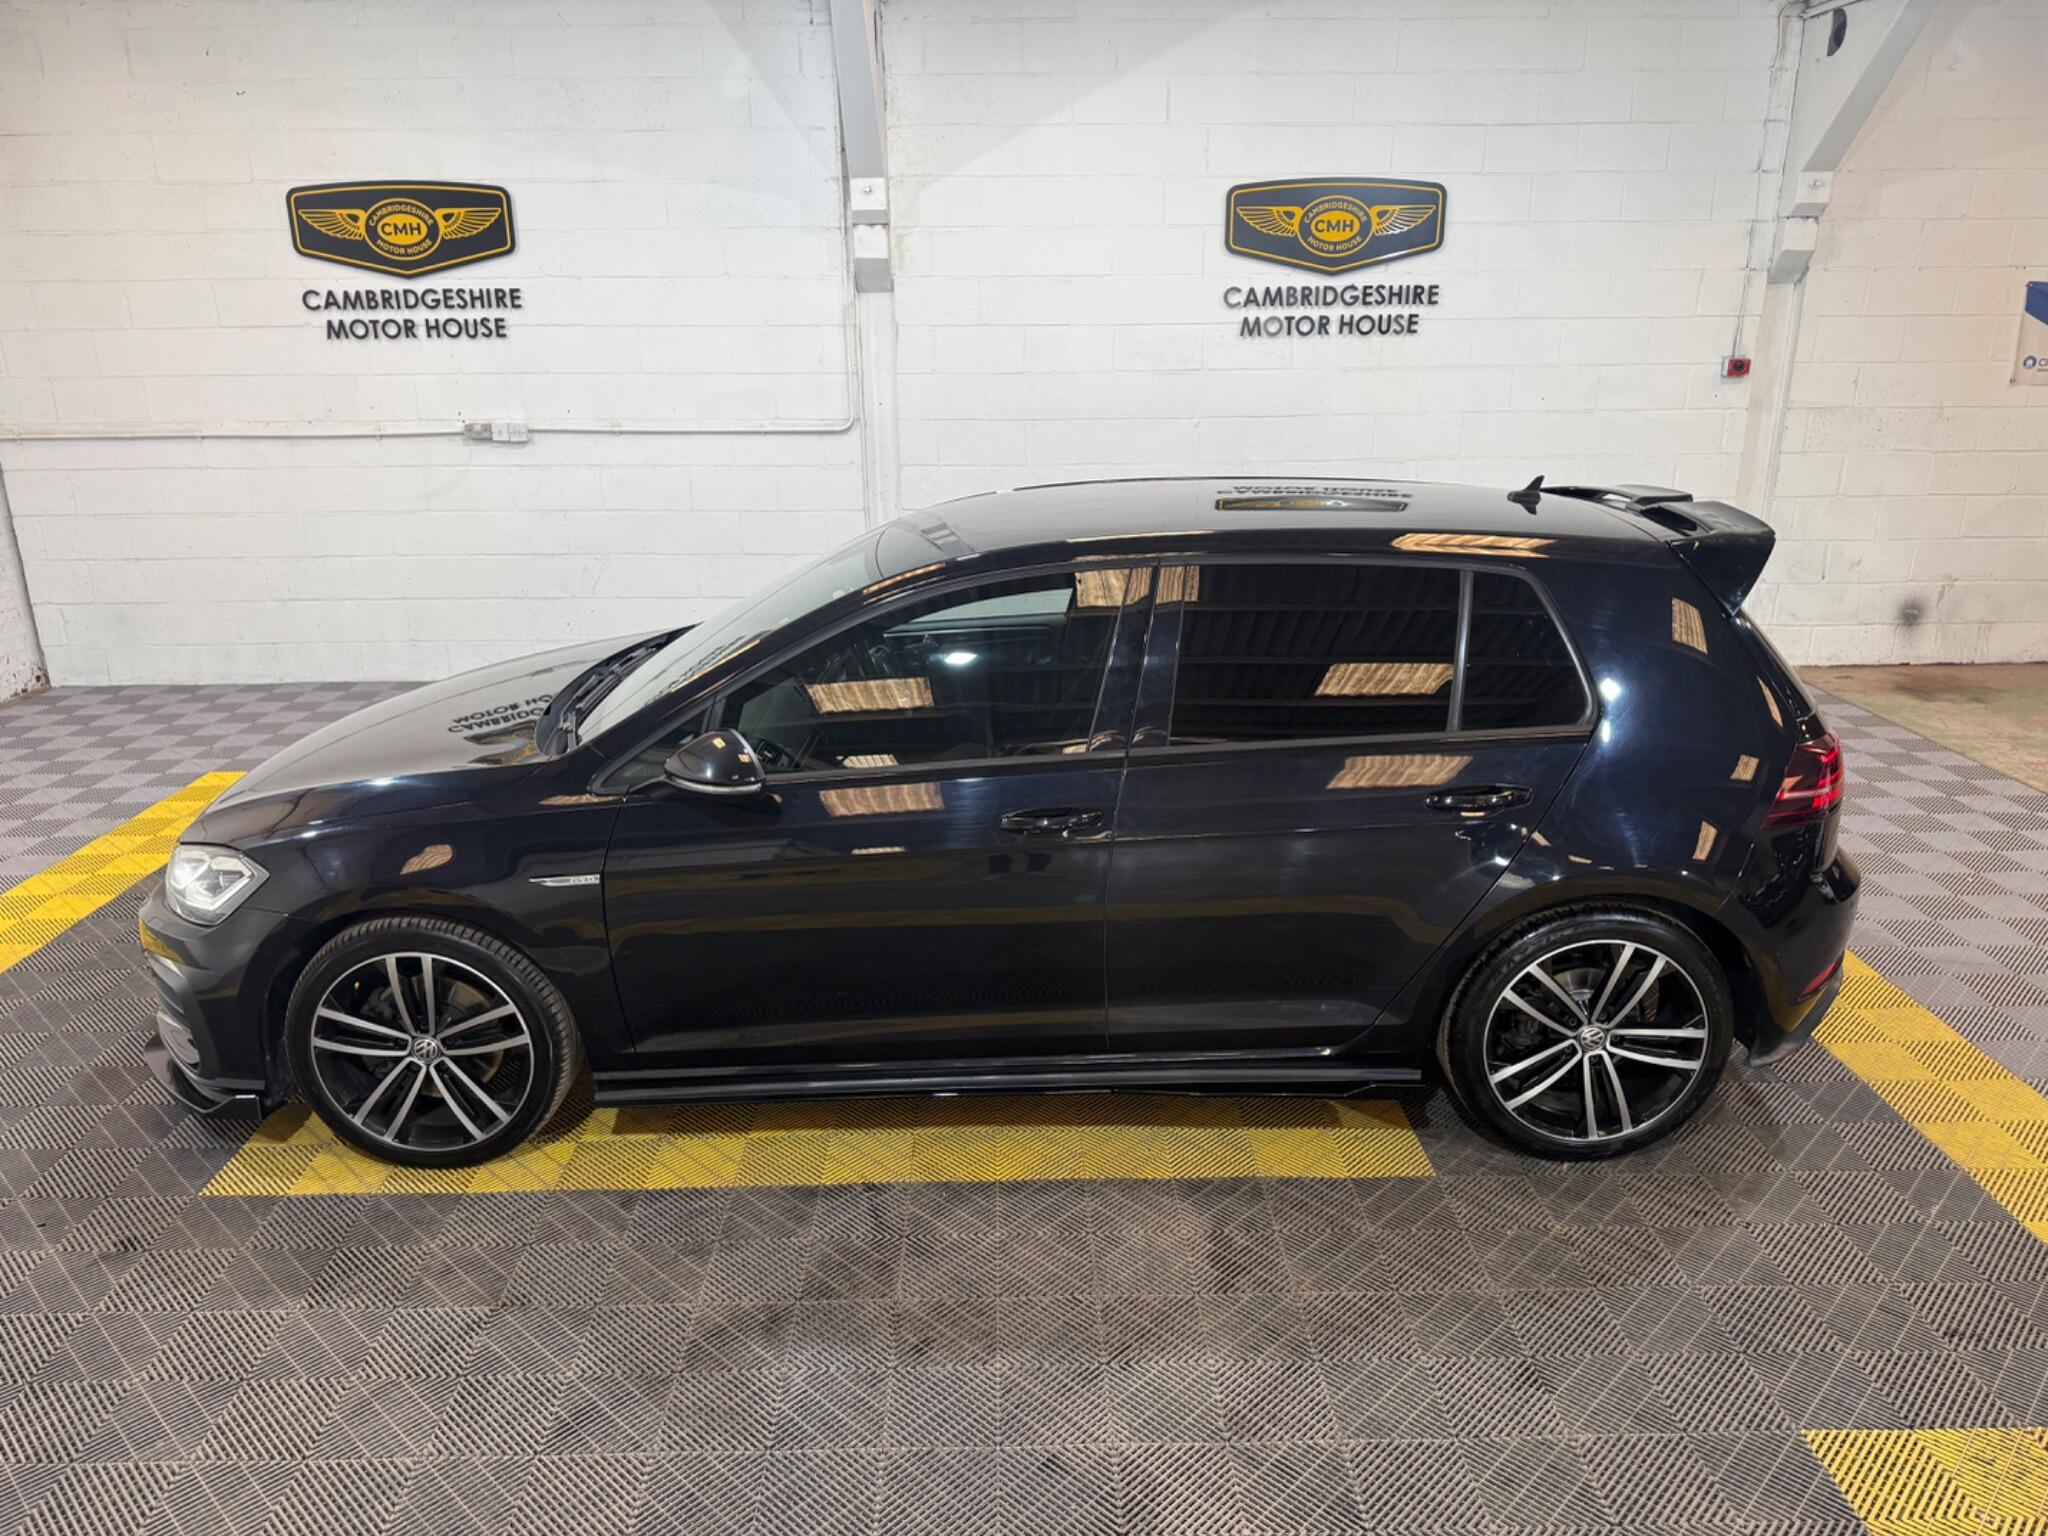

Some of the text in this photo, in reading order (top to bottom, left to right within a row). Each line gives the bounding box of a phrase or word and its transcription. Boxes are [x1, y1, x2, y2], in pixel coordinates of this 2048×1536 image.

[369, 204, 433, 226] CAMBRIDGESHIRE
[1304, 201, 1367, 223] CAMBRIDGESHIRE
[381, 222, 421, 236] CMH
[1314, 219, 1354, 233] CMH
[376, 238, 433, 255] MOTOR HOUSE
[1308, 235, 1362, 251] MOTOR HOUSE
[302, 287, 522, 311] CAMBRIDGESHIRE
[1223, 284, 1439, 309] CAMBRIDGESHIRE
[326, 317, 507, 340] MOTOR HOUSE
[1239, 313, 1419, 337] MOTOR HOUSE
